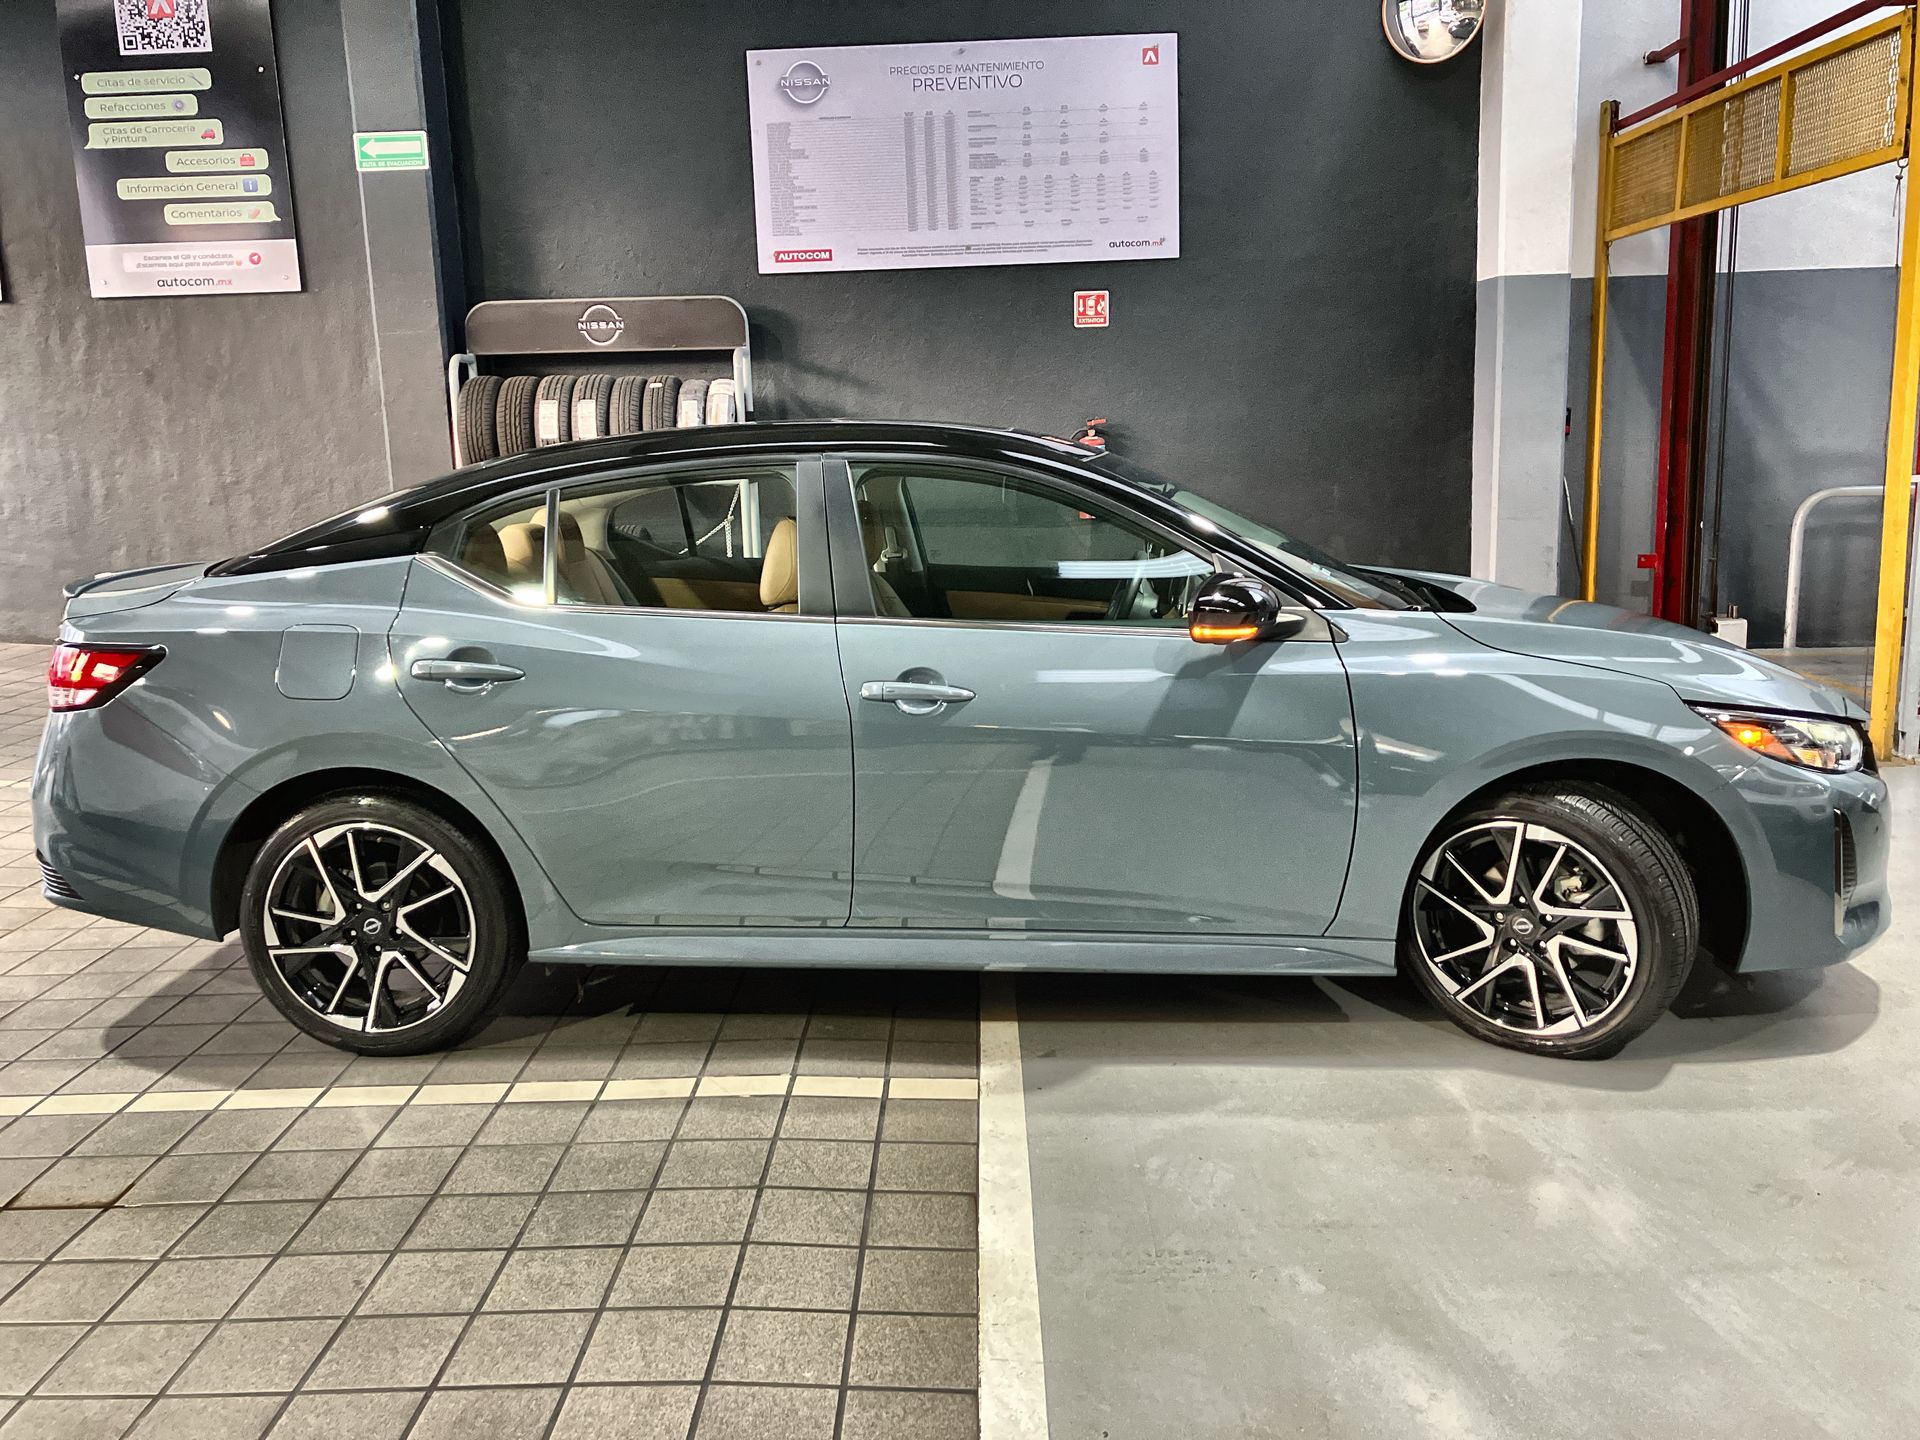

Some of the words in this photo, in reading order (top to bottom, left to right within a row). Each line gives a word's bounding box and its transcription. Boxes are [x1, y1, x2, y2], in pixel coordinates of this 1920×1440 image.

[889, 65, 936, 76] PRECIOS
[938, 64, 952, 74] DE
[955, 60, 1044, 74] MANTENIMIENTO
[96, 78, 125, 88] Citas
[127, 77, 140, 86] de
[144, 76, 186, 86] servicio
[780, 77, 830, 87] NISSAN
[912, 74, 1023, 92] PREVENTIVO
[100, 102, 166, 112] Refacciones
[102, 127, 128, 135] Citas
[130, 126, 142, 134] de
[112, 136, 148, 144] Pintura
[176, 156, 236, 166] Accesorios
[127, 182, 194, 194] Información
[196, 182, 238, 192] General
[171, 208, 242, 219] Comentarios
[1108, 239, 1164, 248] autocom.mx
[778, 251, 830, 262] AUTOCOM
[157, 277, 232, 288] autocom.mx
[578, 321, 624, 329] NISSAN
